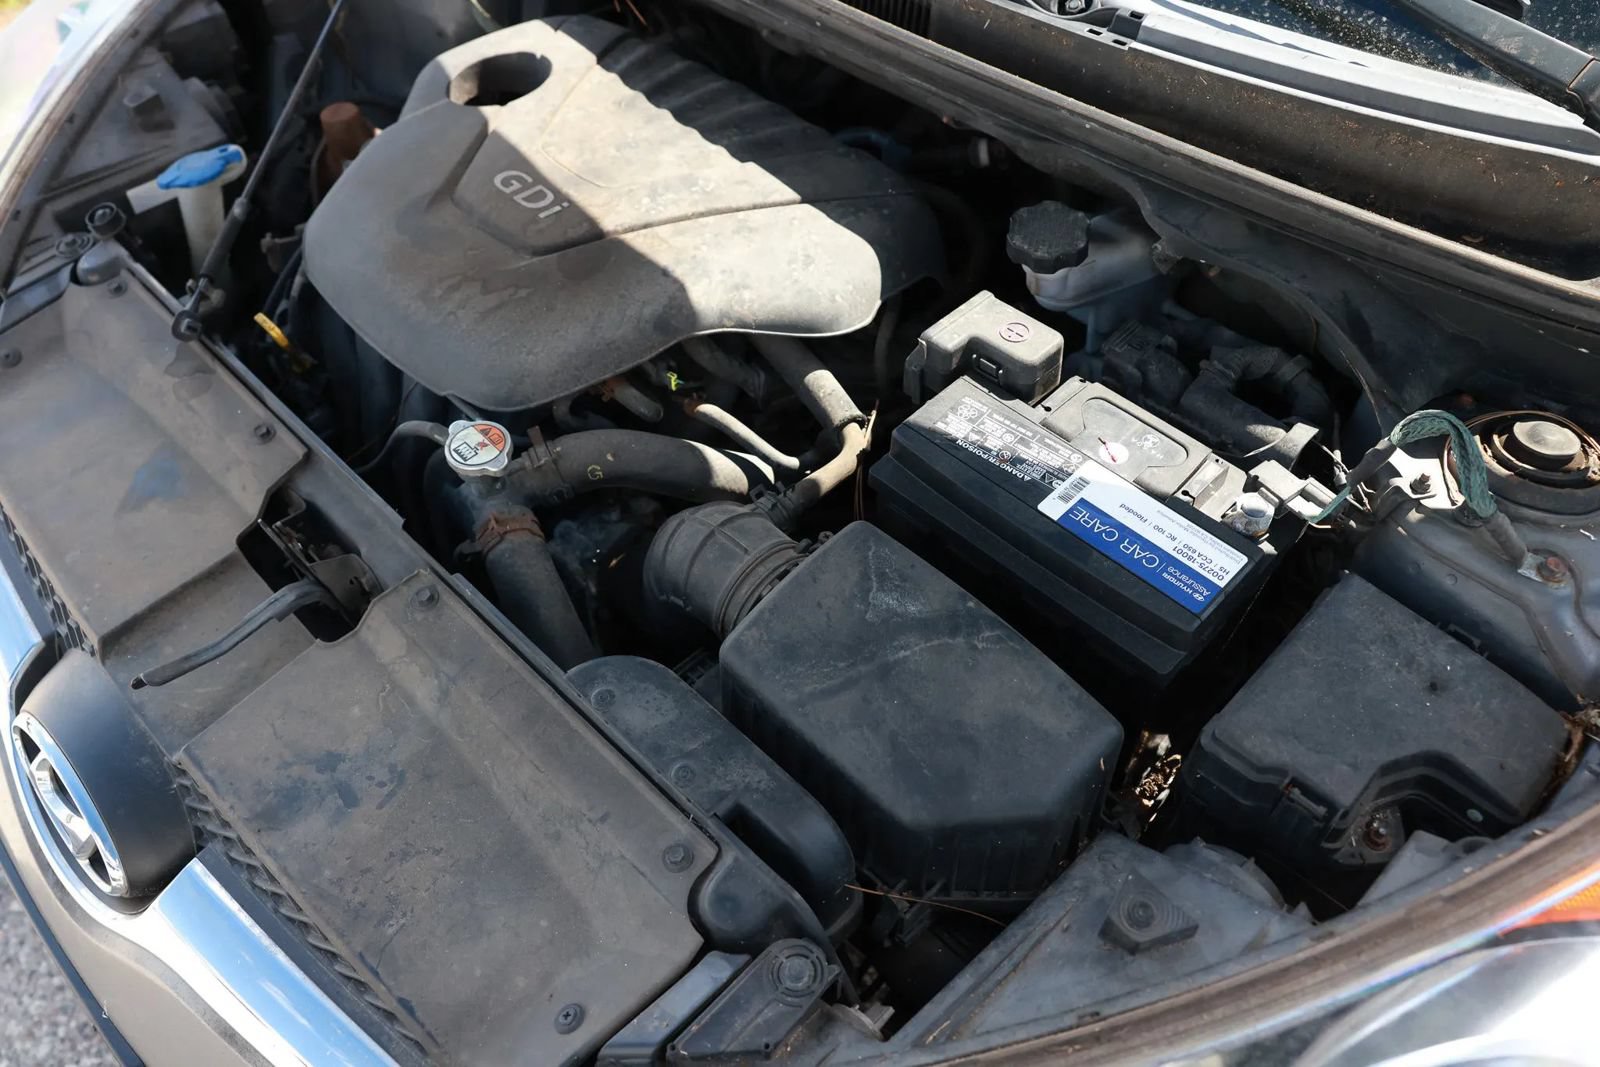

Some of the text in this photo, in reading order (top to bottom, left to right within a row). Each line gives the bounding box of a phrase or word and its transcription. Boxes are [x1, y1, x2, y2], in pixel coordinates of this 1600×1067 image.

[494, 170, 570, 218] GDi
[1068, 506, 1119, 542] CARE
[1119, 503, 1148, 524] Flooded
[1153, 524, 1165, 534] 100
[1165, 532, 1177, 541] RC
[1120, 538, 1159, 568] CAR
[1182, 543, 1197, 554] 650
[1197, 552, 1213, 565] CCA
[1172, 545, 1225, 581] 00275-18001
[1167, 566, 1211, 596] Assurance
